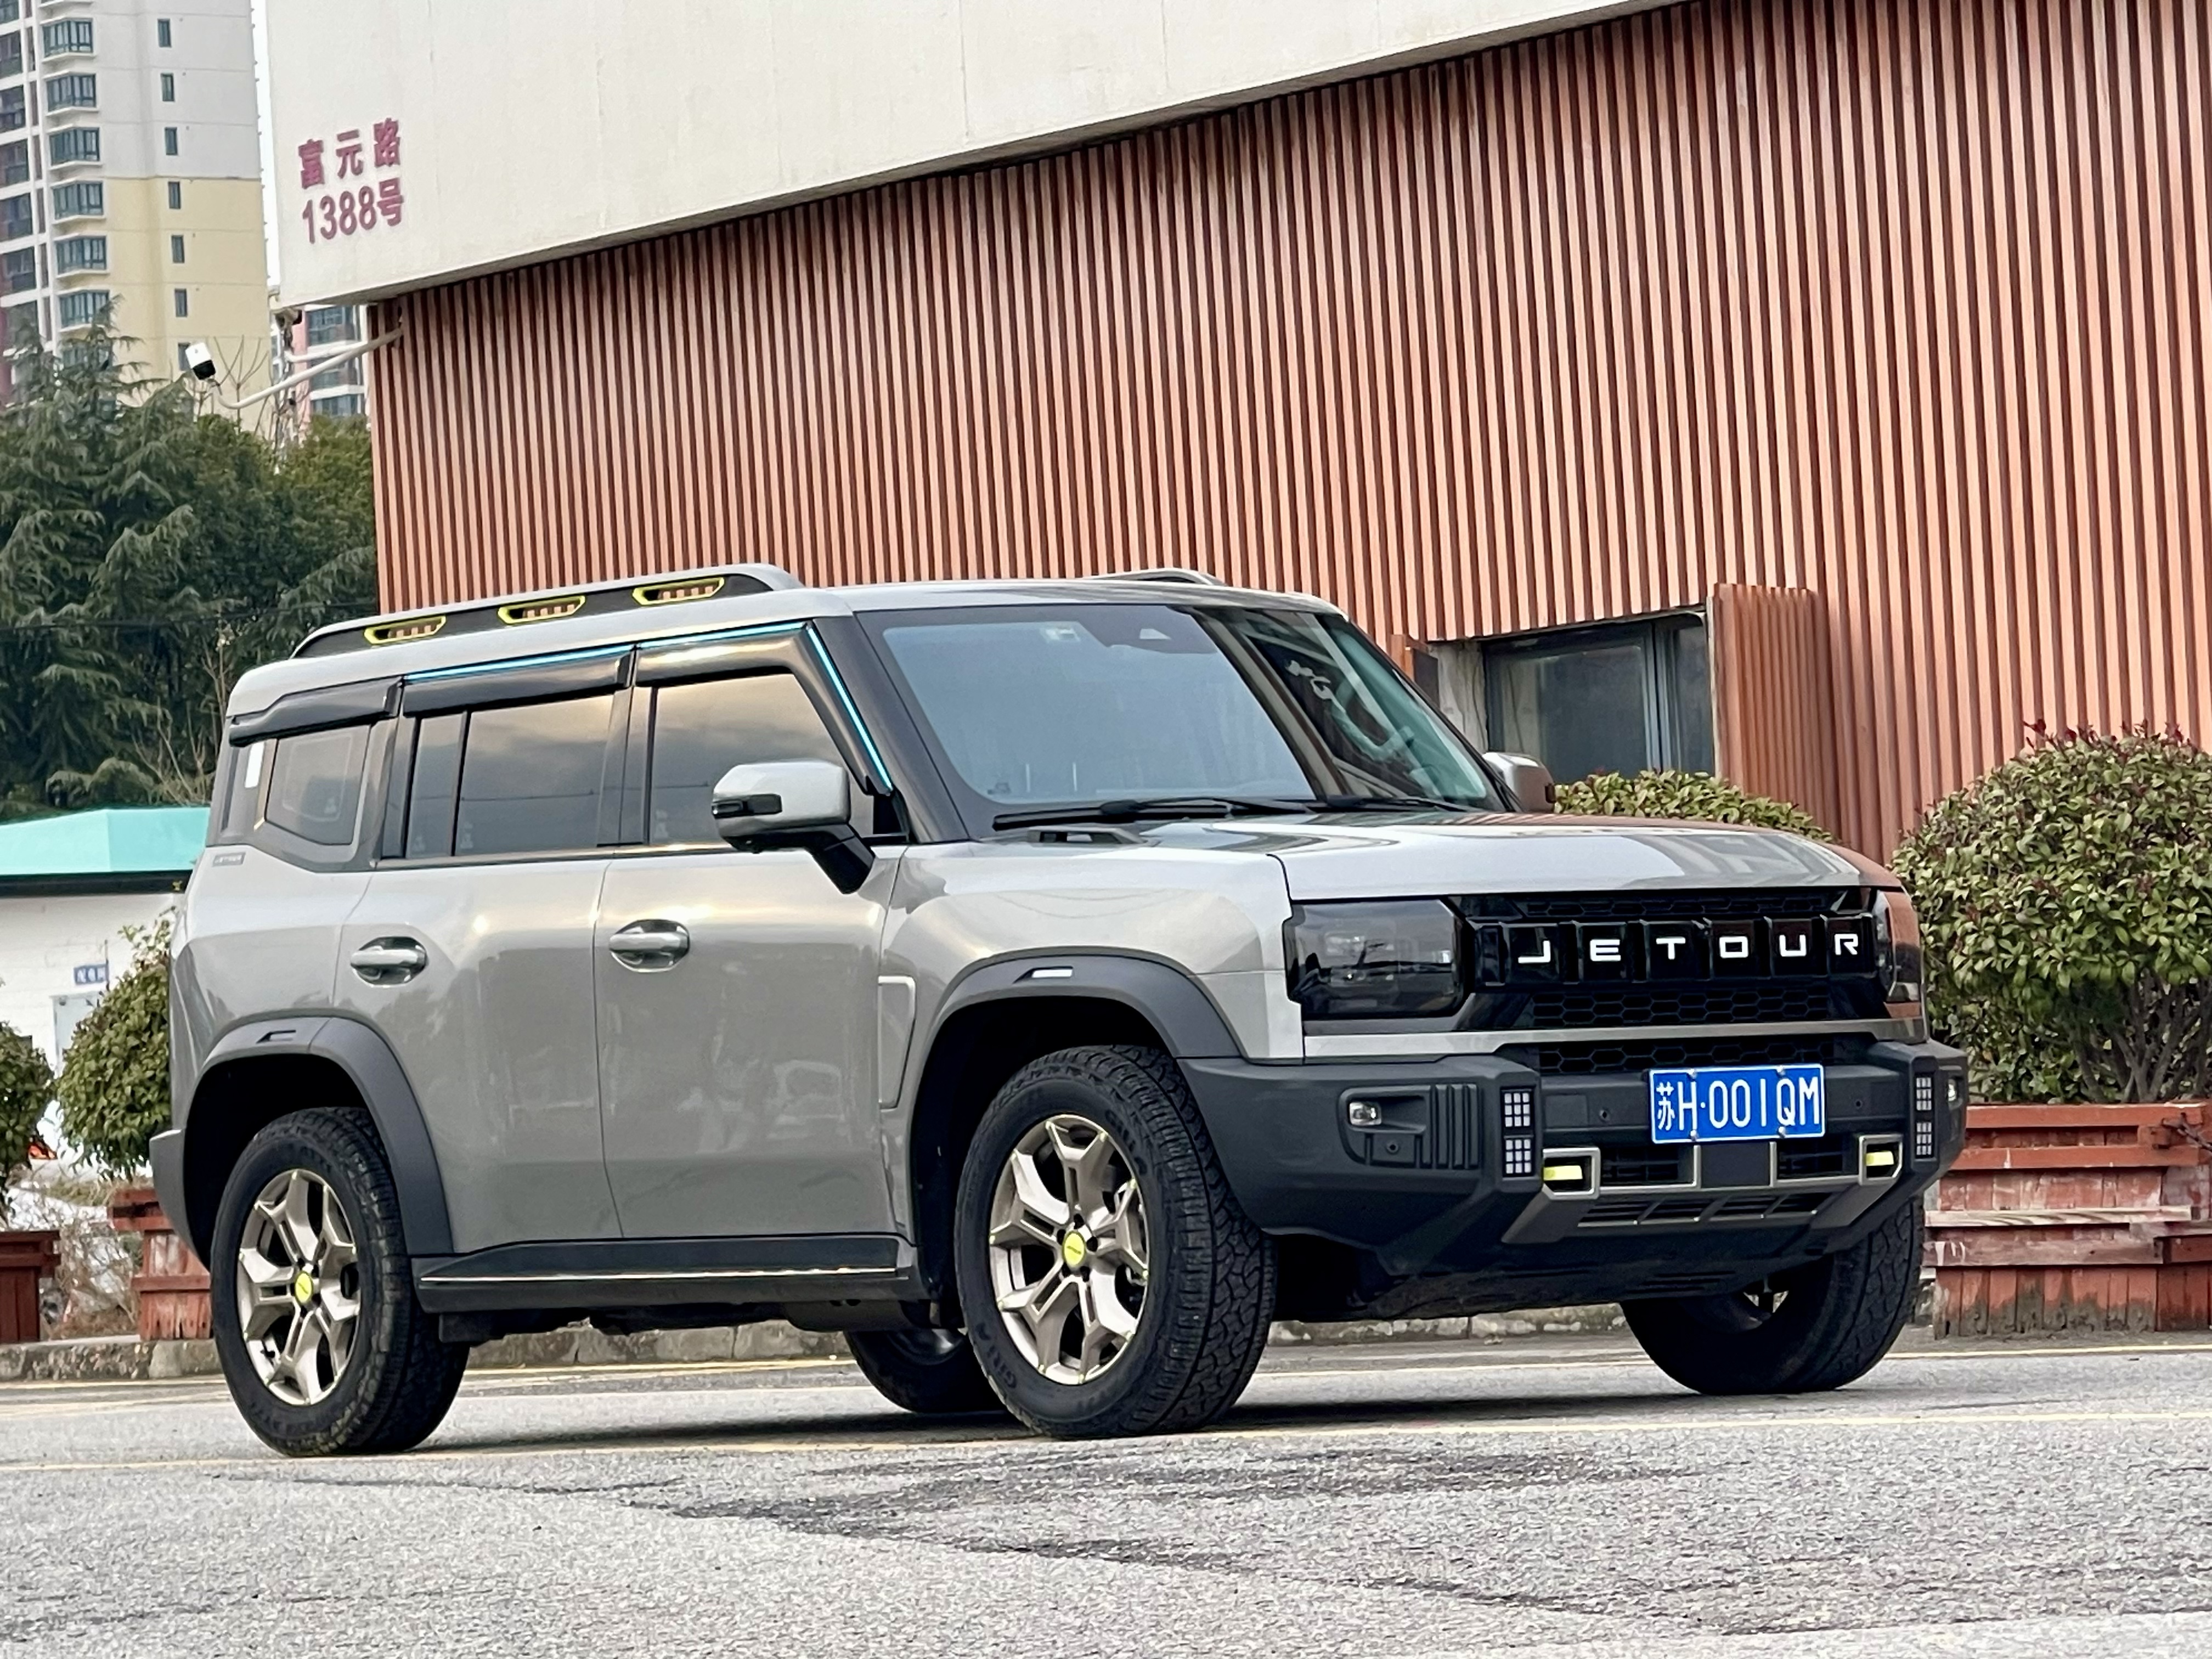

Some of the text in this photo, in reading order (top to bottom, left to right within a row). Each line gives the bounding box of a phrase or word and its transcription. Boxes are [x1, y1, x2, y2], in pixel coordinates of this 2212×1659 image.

[298, 118, 400, 190] 富元路
[302, 177, 404, 244] 1388号
[1518, 933, 1859, 963] JETOUR
